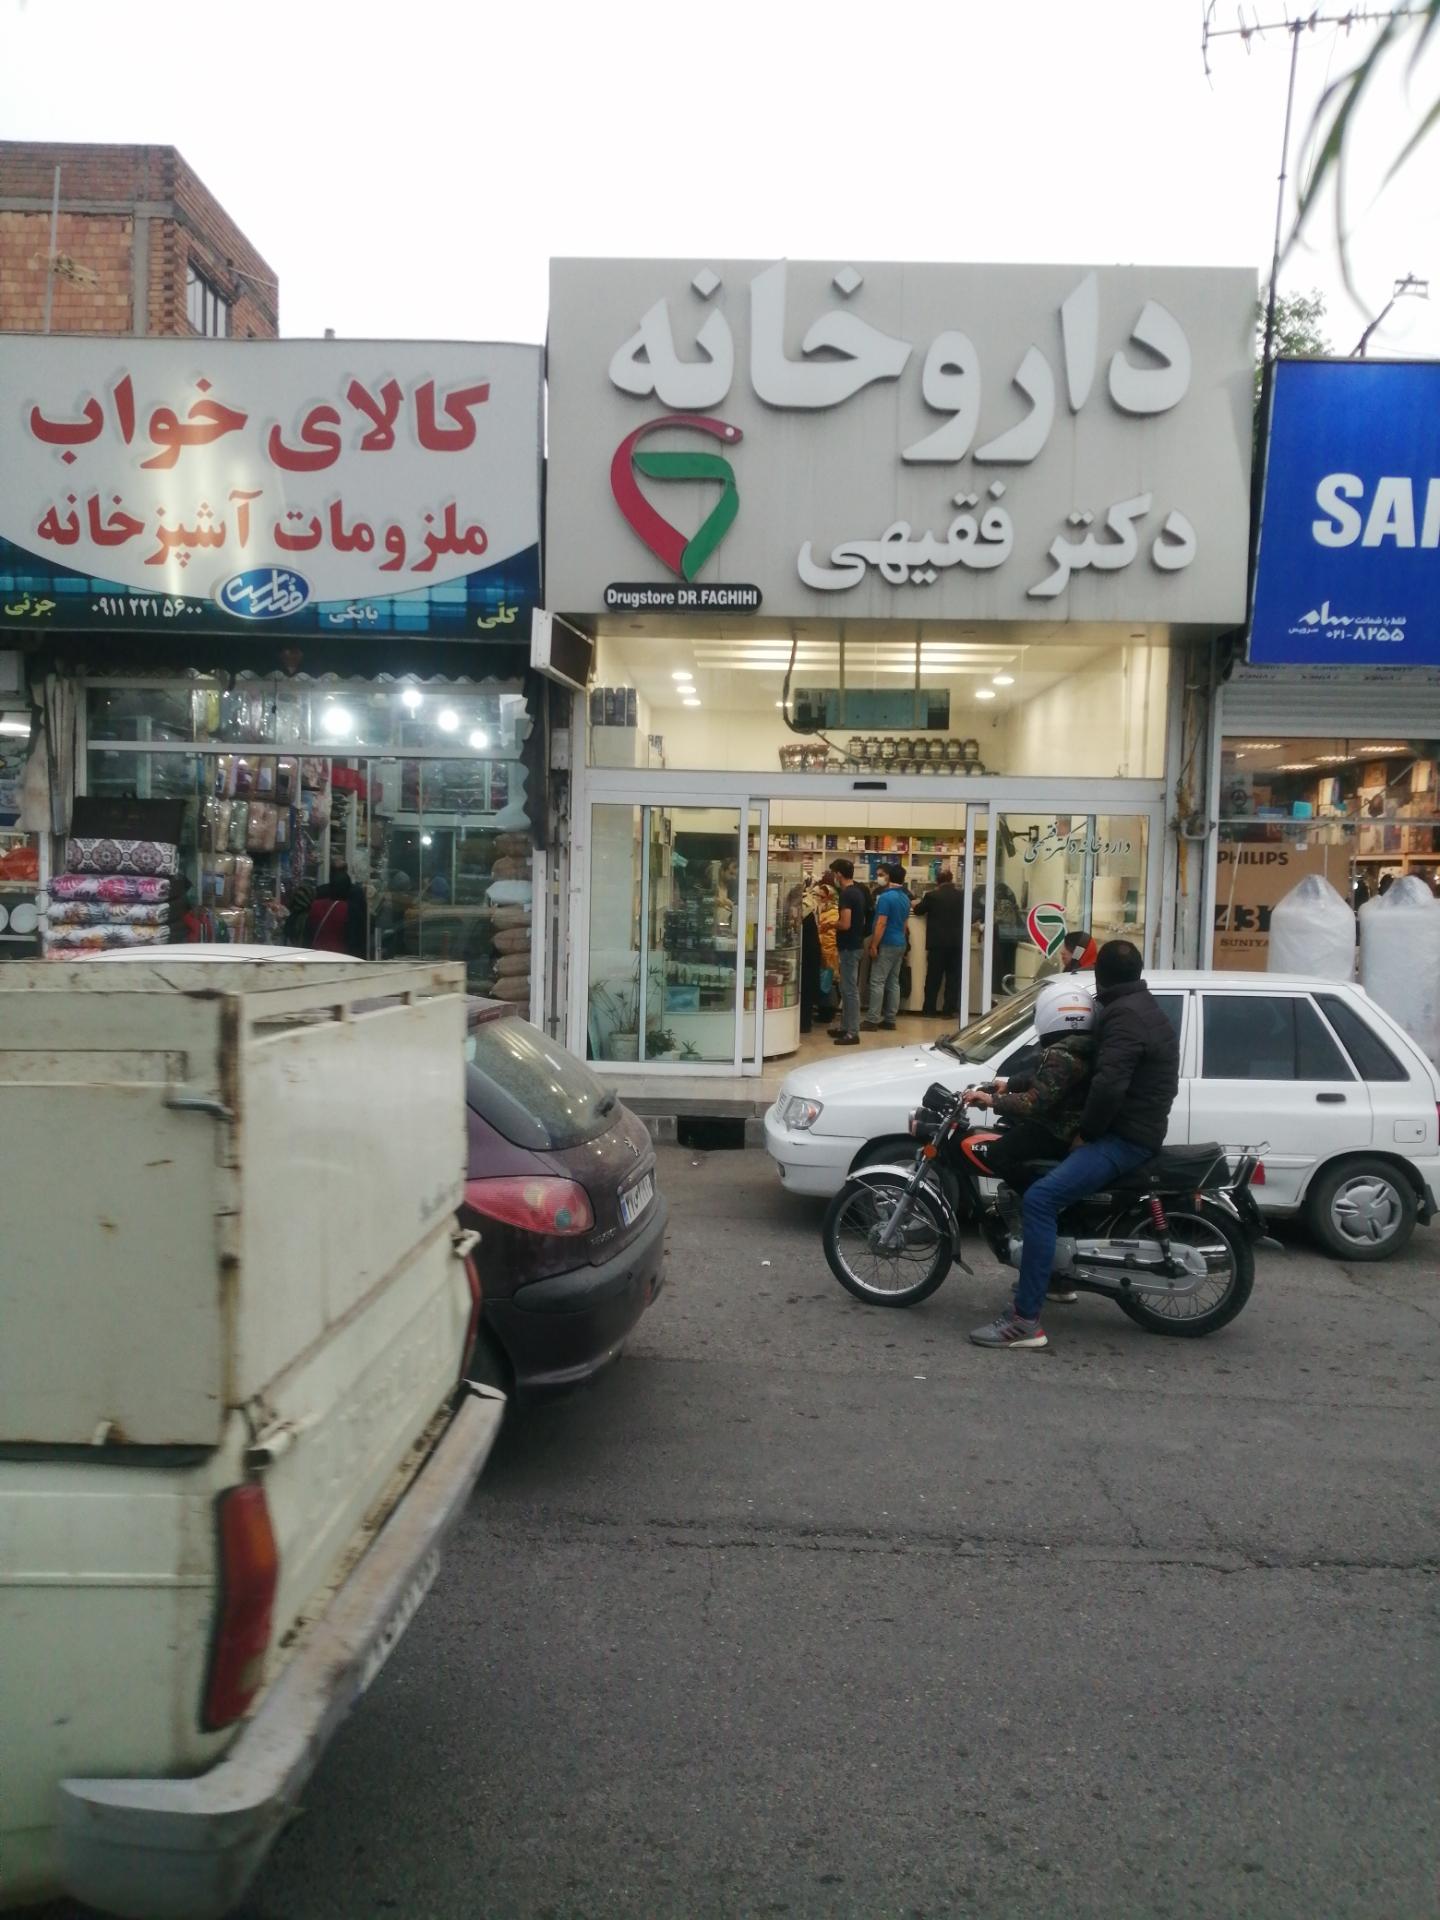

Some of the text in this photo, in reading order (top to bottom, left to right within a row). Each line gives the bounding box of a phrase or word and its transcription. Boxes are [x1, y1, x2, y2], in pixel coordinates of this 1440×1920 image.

[608, 259, 1192, 463] داروخانه
[29, 373, 491, 473] کالای خواب
[36, 489, 488, 572] ملزومات آشپزخانه
[797, 479, 1197, 597] دکتر فقیهی
[606, 588, 675, 608] Drugstore
[1217, 851, 1289, 866] PHILIPS
